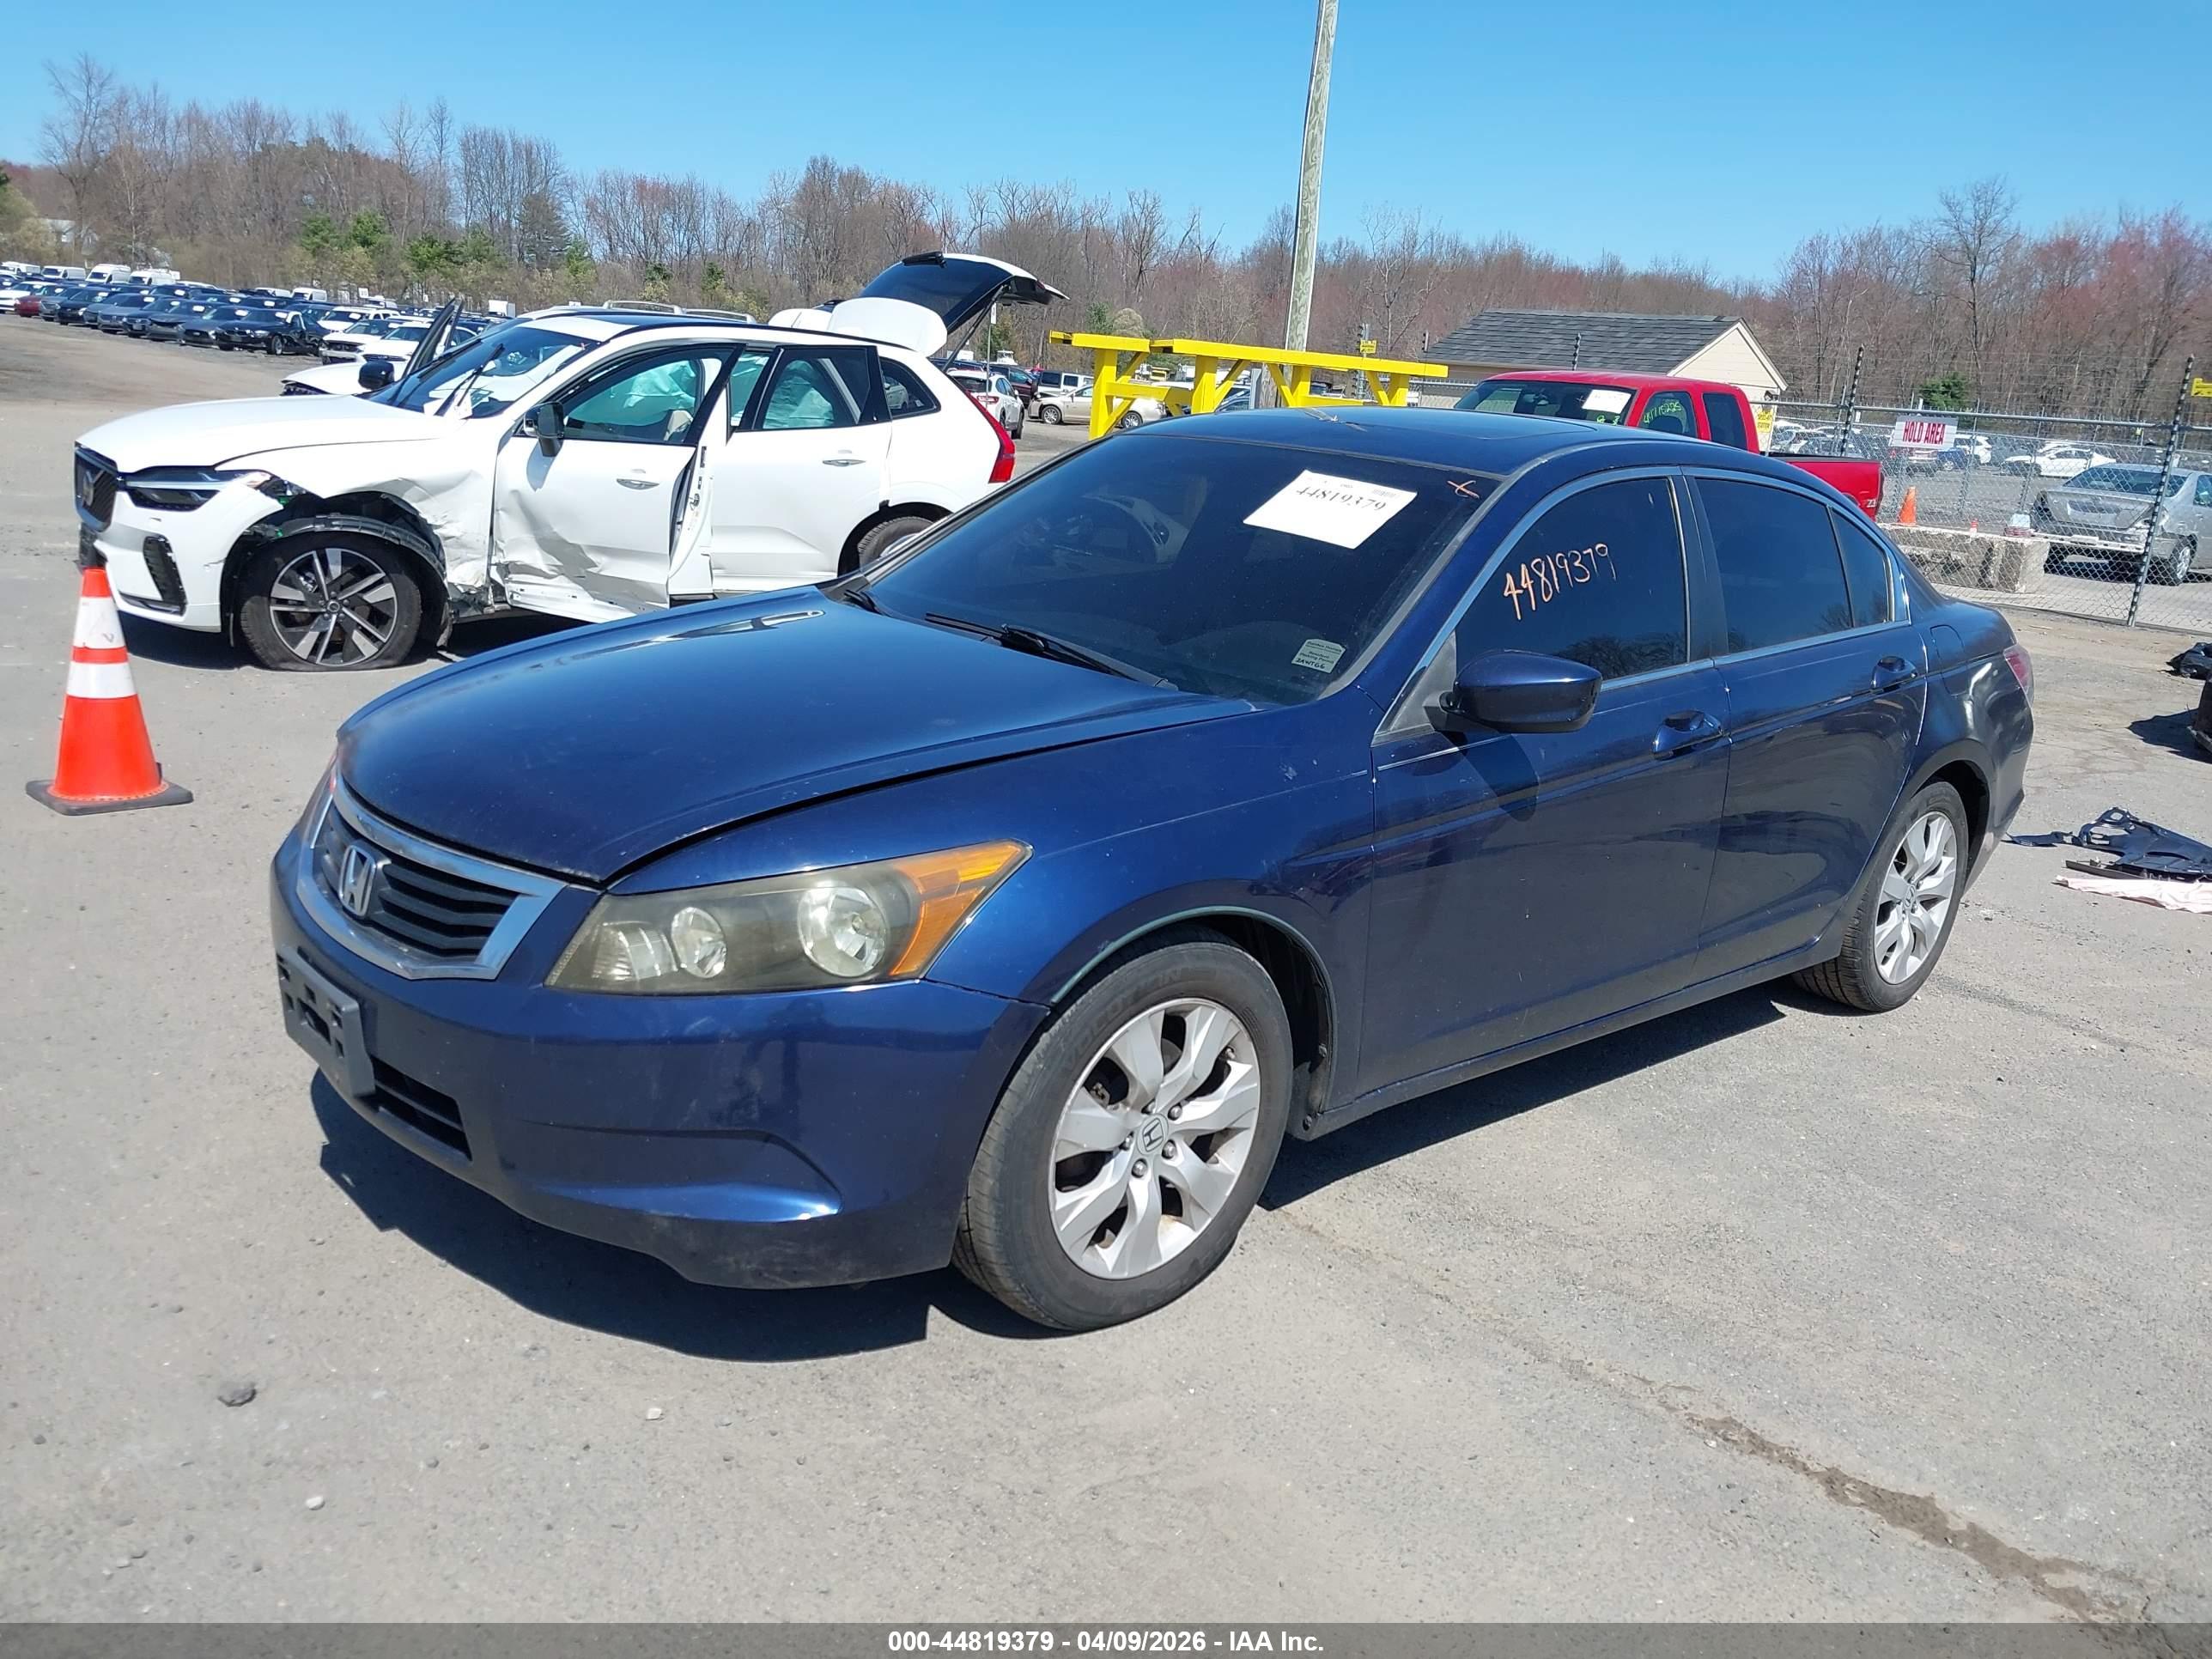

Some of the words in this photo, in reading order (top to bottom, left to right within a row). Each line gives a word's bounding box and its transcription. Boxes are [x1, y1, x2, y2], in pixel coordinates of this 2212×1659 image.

[1903, 421, 1923, 443] HOLD
[1923, 422, 1946, 445] AREA
[1297, 486, 1387, 511] 44819379
[1504, 543, 1617, 620] 44819379
